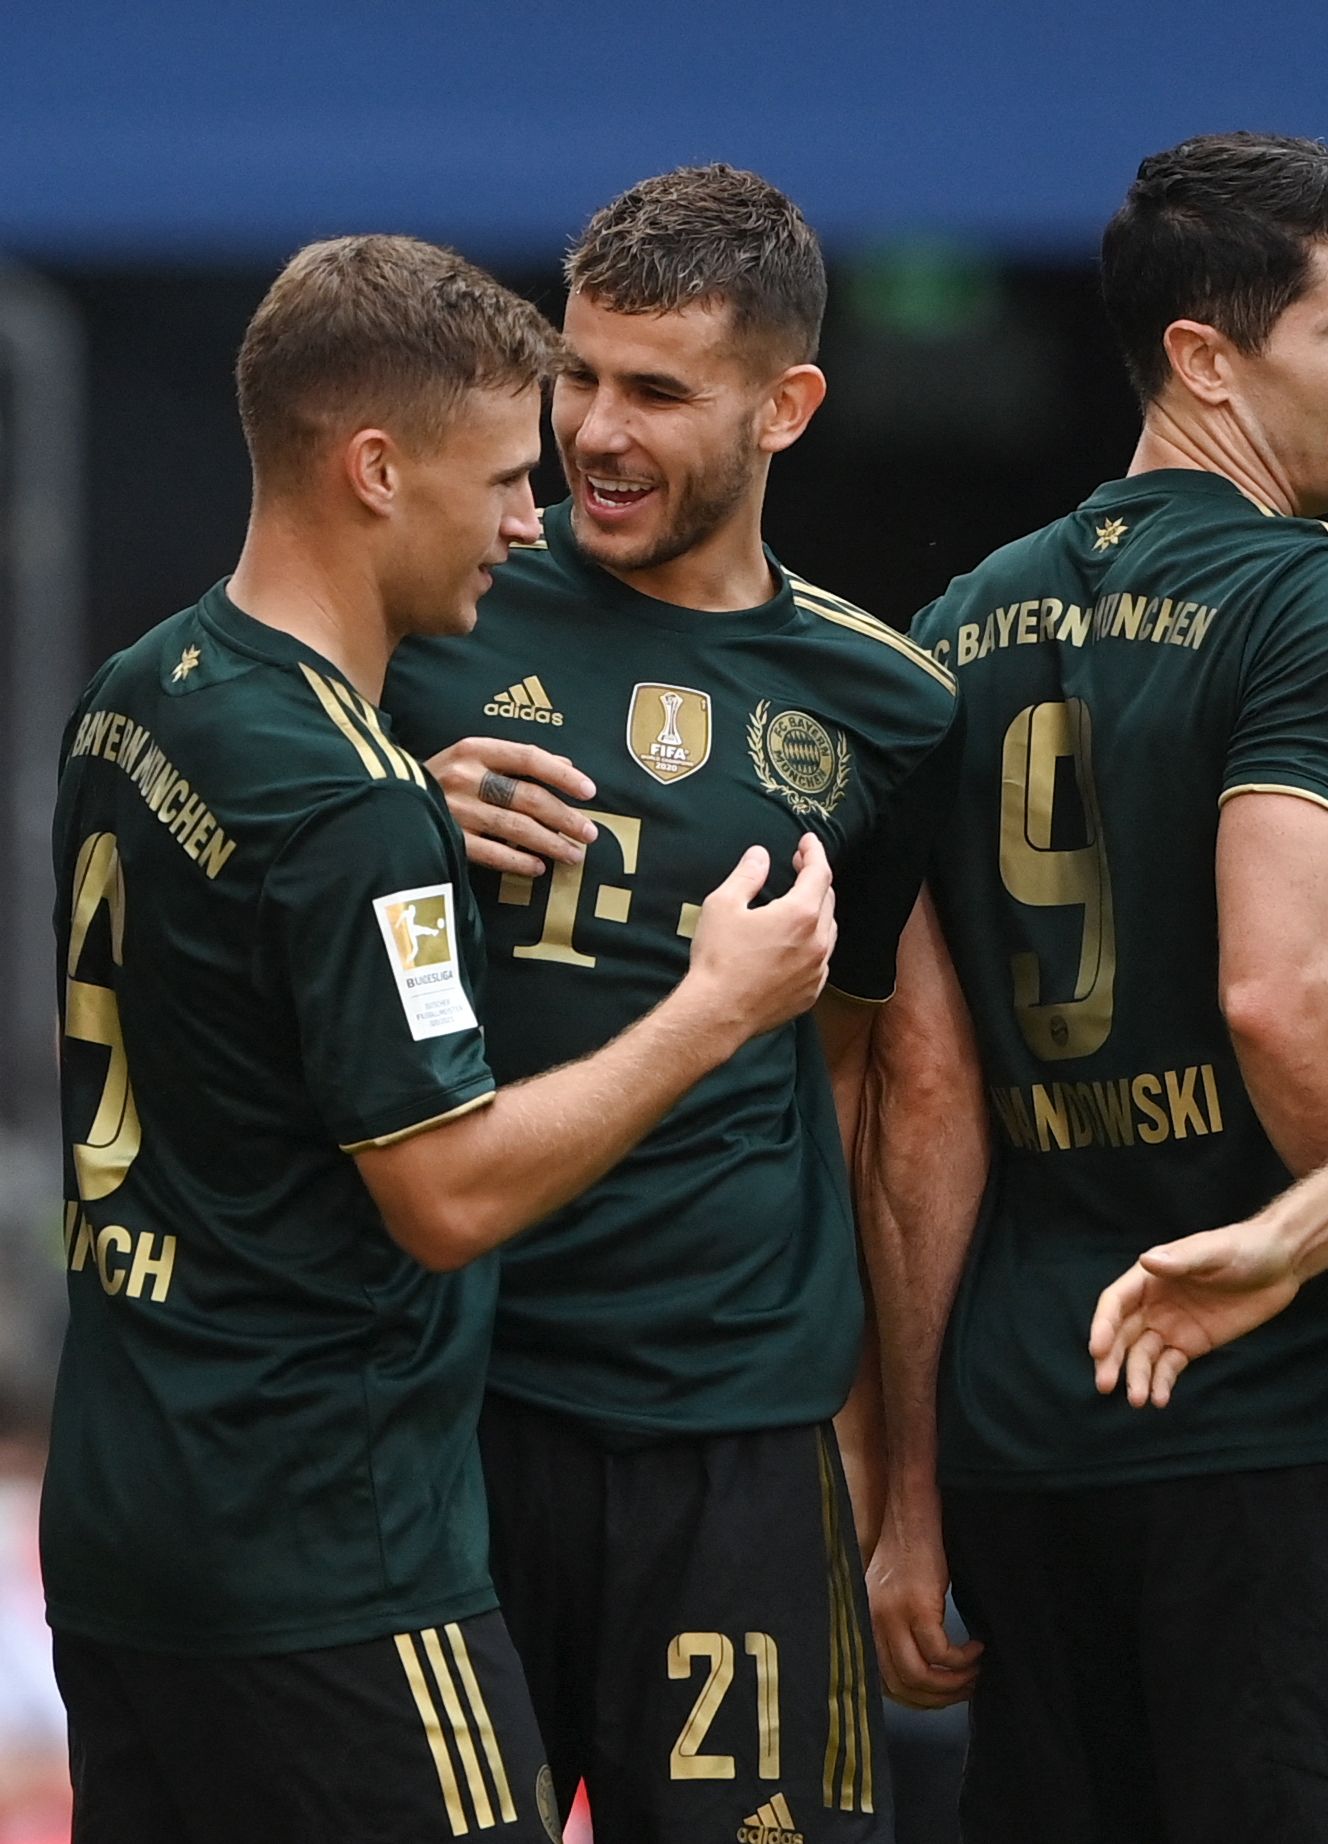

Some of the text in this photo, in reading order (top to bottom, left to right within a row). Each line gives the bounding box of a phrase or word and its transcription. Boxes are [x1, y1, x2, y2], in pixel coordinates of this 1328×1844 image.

[957, 597, 1093, 667] BAYERN
[483, 702, 564, 727] adidas
[788, 716, 830, 757] BAYERN
[71, 710, 150, 774] BAYERN
[650, 743, 686, 760] FIFA
[1000, 701, 1117, 1062] 9
[667, 1632, 780, 1780] 21
[736, 1825, 804, 1844] adidas
